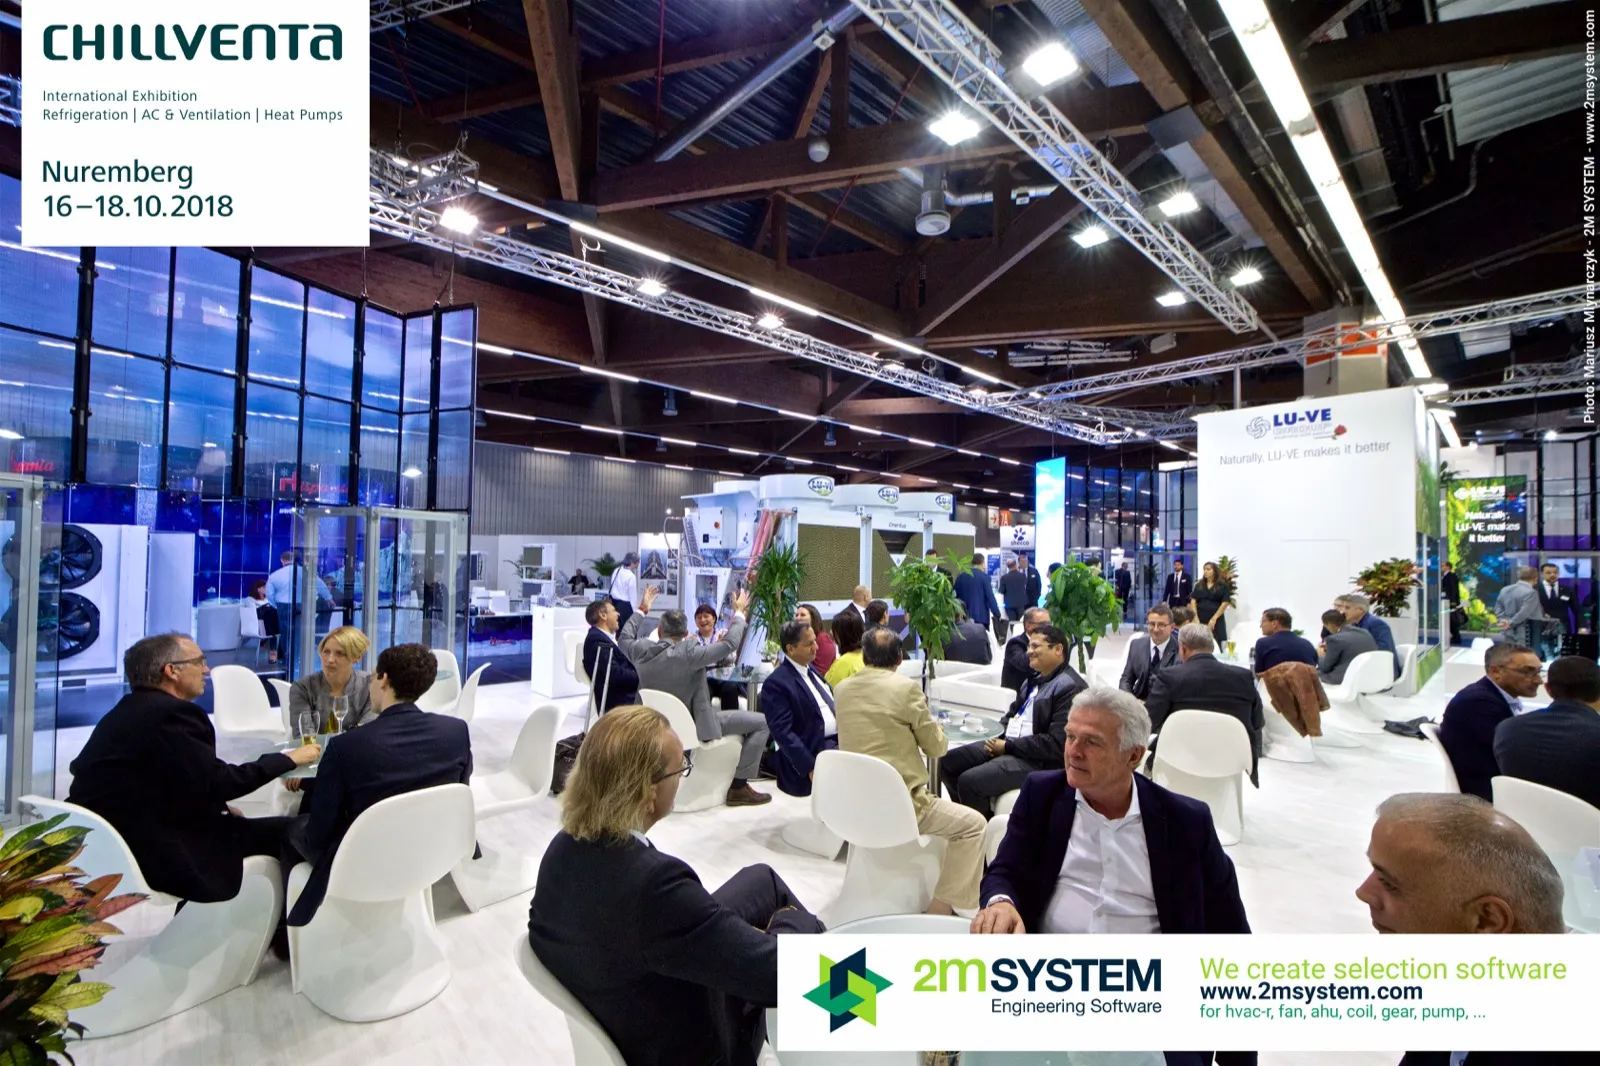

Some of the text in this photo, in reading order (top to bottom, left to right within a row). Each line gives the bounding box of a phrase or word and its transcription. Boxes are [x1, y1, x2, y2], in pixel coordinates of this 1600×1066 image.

[1273, 408, 1332, 427] LU-VE
[1267, 448, 1300, 462] LU-VE
[1303, 445, 1341, 458] makes
[1344, 443, 1352, 455] it
[1355, 441, 1392, 454] better
[1455, 522, 1486, 532] LU-VE
[1477, 533, 1506, 543] better
